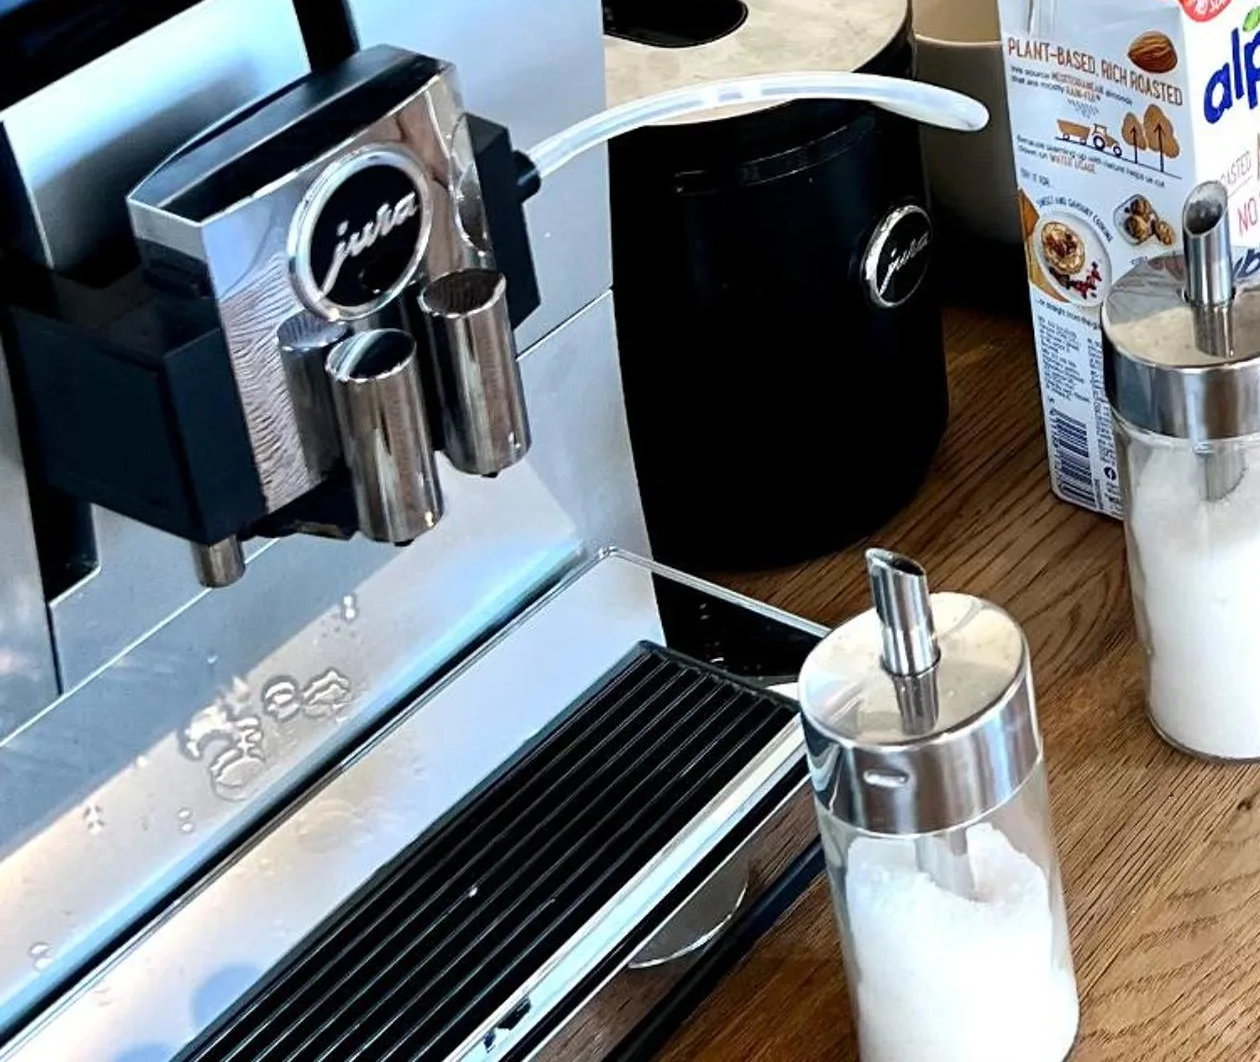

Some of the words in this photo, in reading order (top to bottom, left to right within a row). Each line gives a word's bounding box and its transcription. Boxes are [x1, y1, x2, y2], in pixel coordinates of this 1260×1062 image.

[1101, 59, 1127, 86] RICH
[1130, 71, 1183, 106] ROASTED
[320, 191, 420, 296] jura
[1237, 197, 1258, 236] NO
[880, 231, 929, 296] jura
